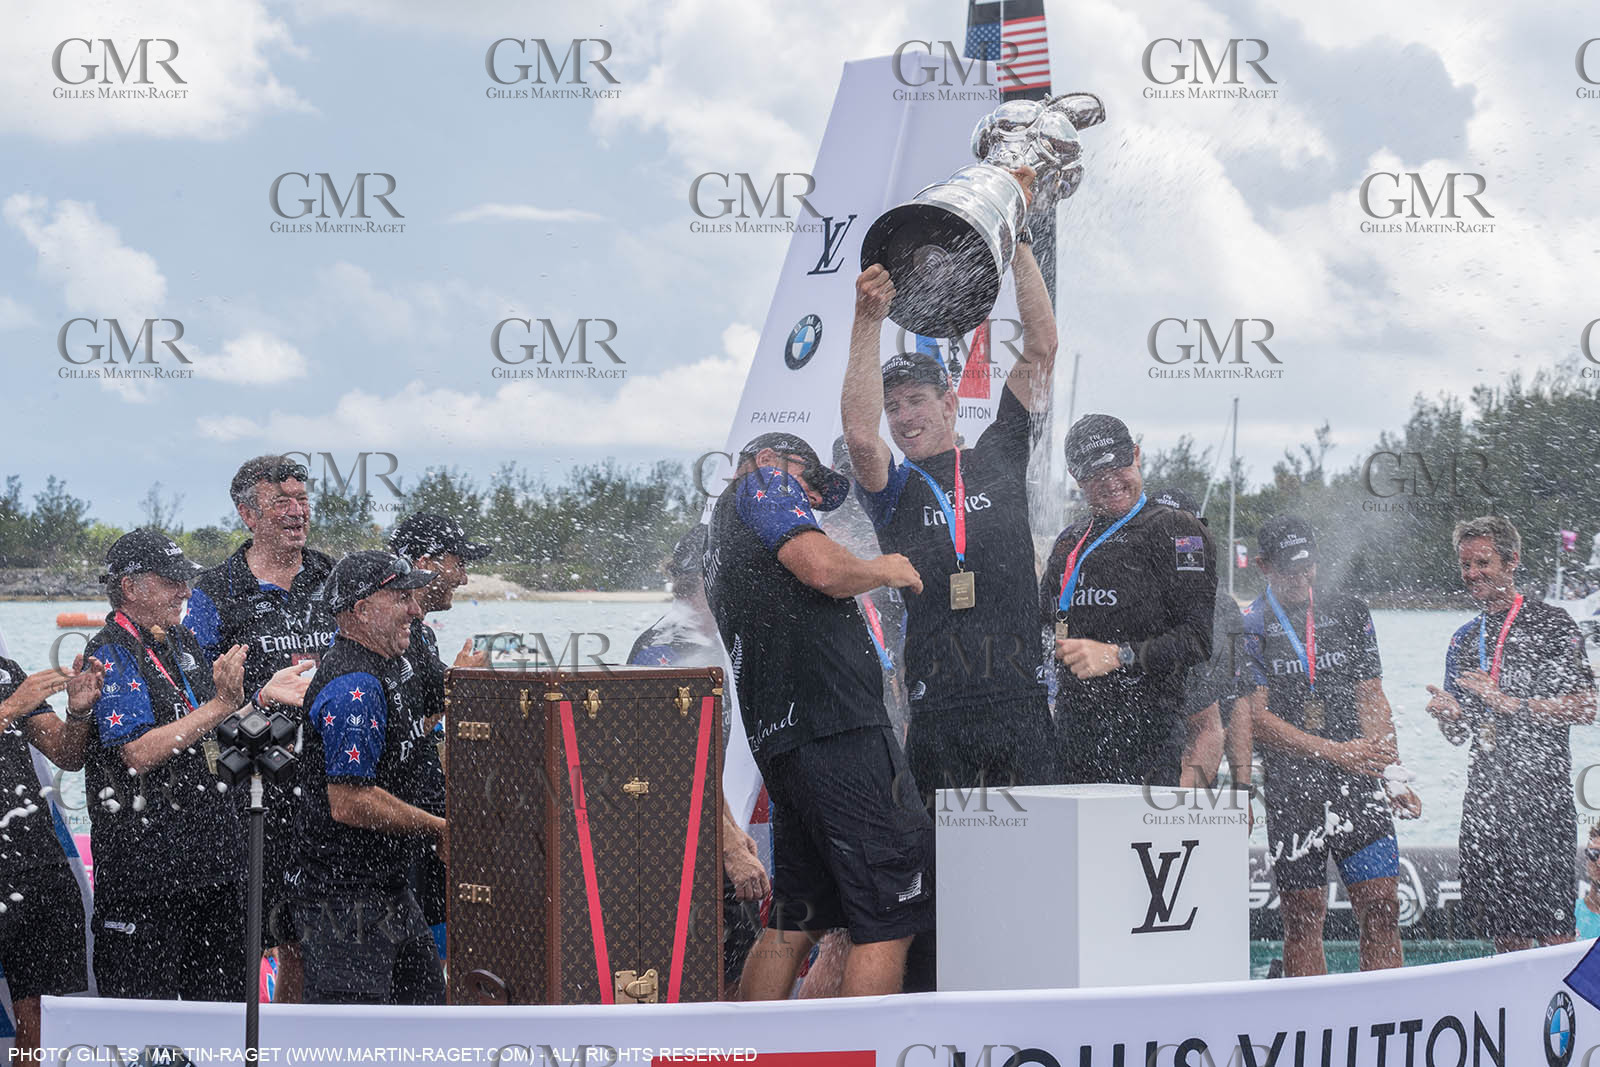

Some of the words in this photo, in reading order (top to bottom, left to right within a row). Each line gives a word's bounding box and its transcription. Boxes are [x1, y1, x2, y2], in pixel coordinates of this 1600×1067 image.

[751, 411, 811, 423] PANERAI
[957, 406, 991, 420] UITTON
[1081, 436, 1115, 454] Emirates
[1272, 650, 1347, 676] Emates
